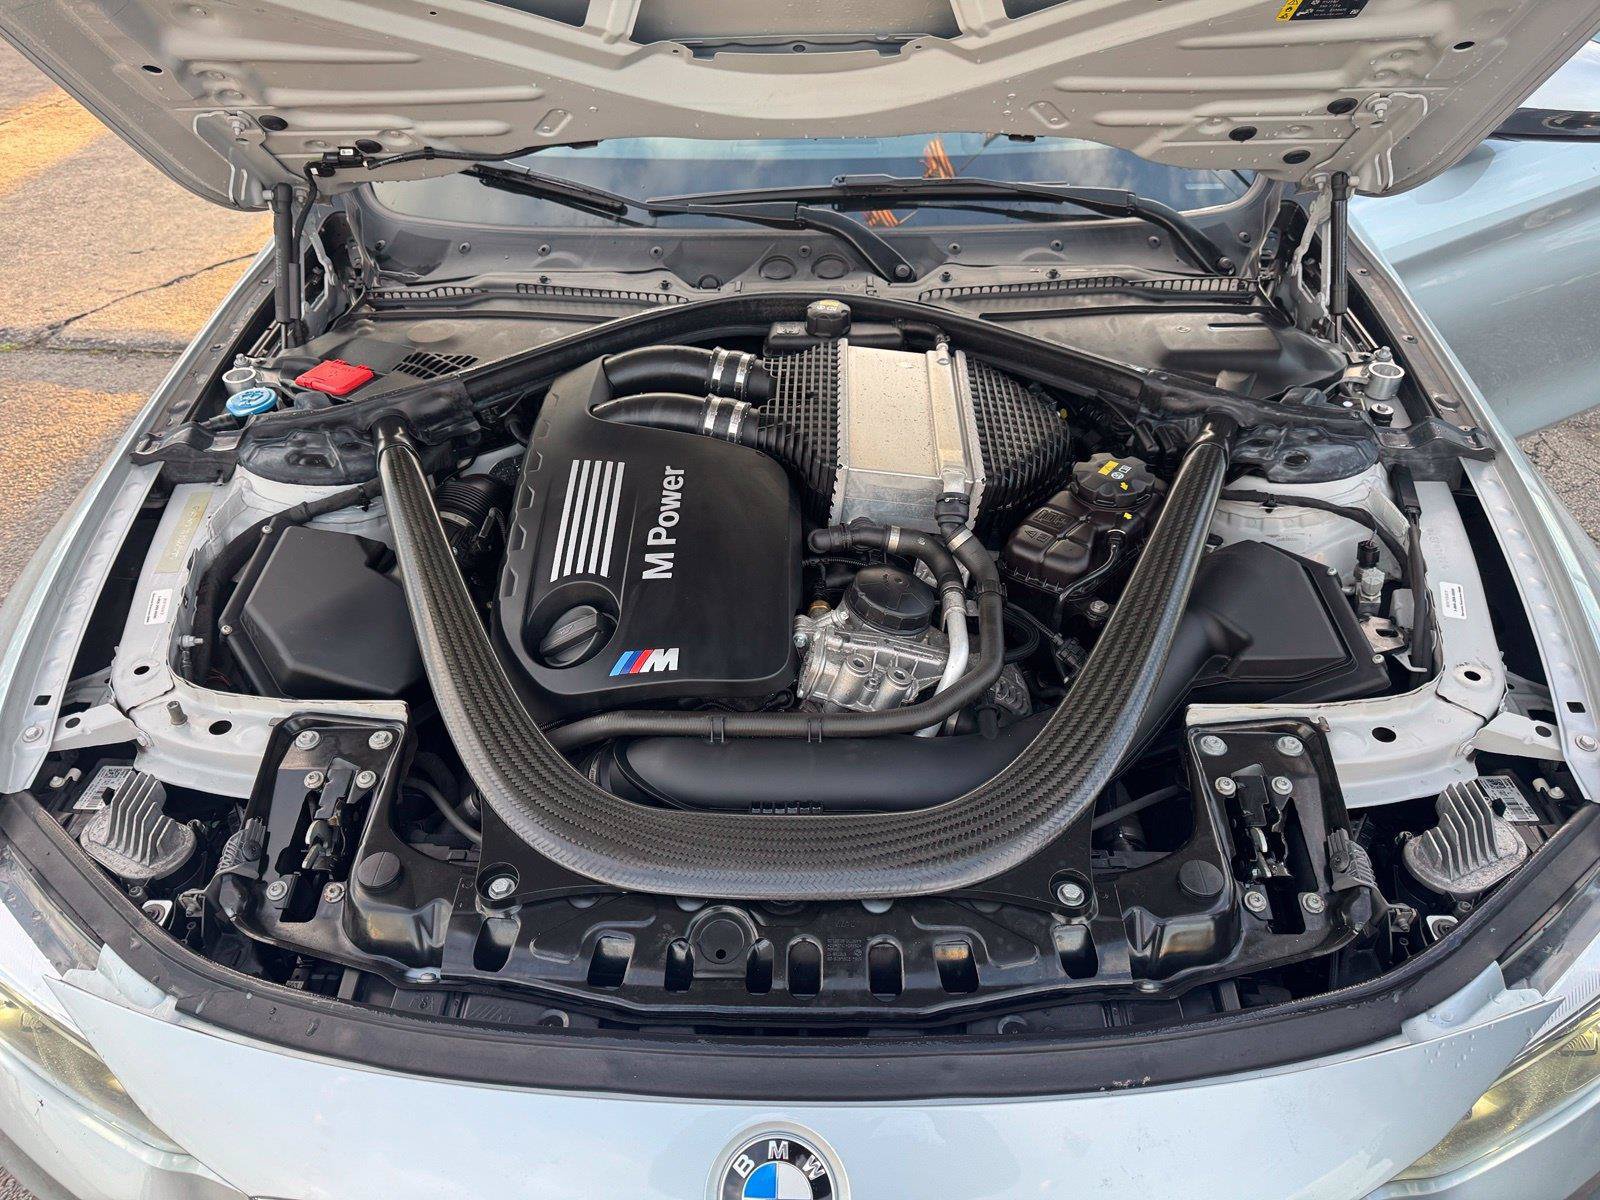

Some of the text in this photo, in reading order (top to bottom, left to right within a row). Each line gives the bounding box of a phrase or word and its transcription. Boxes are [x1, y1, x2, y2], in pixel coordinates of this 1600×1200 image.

[642, 465, 685, 580] M Power
[732, 1140, 826, 1181] BMW
